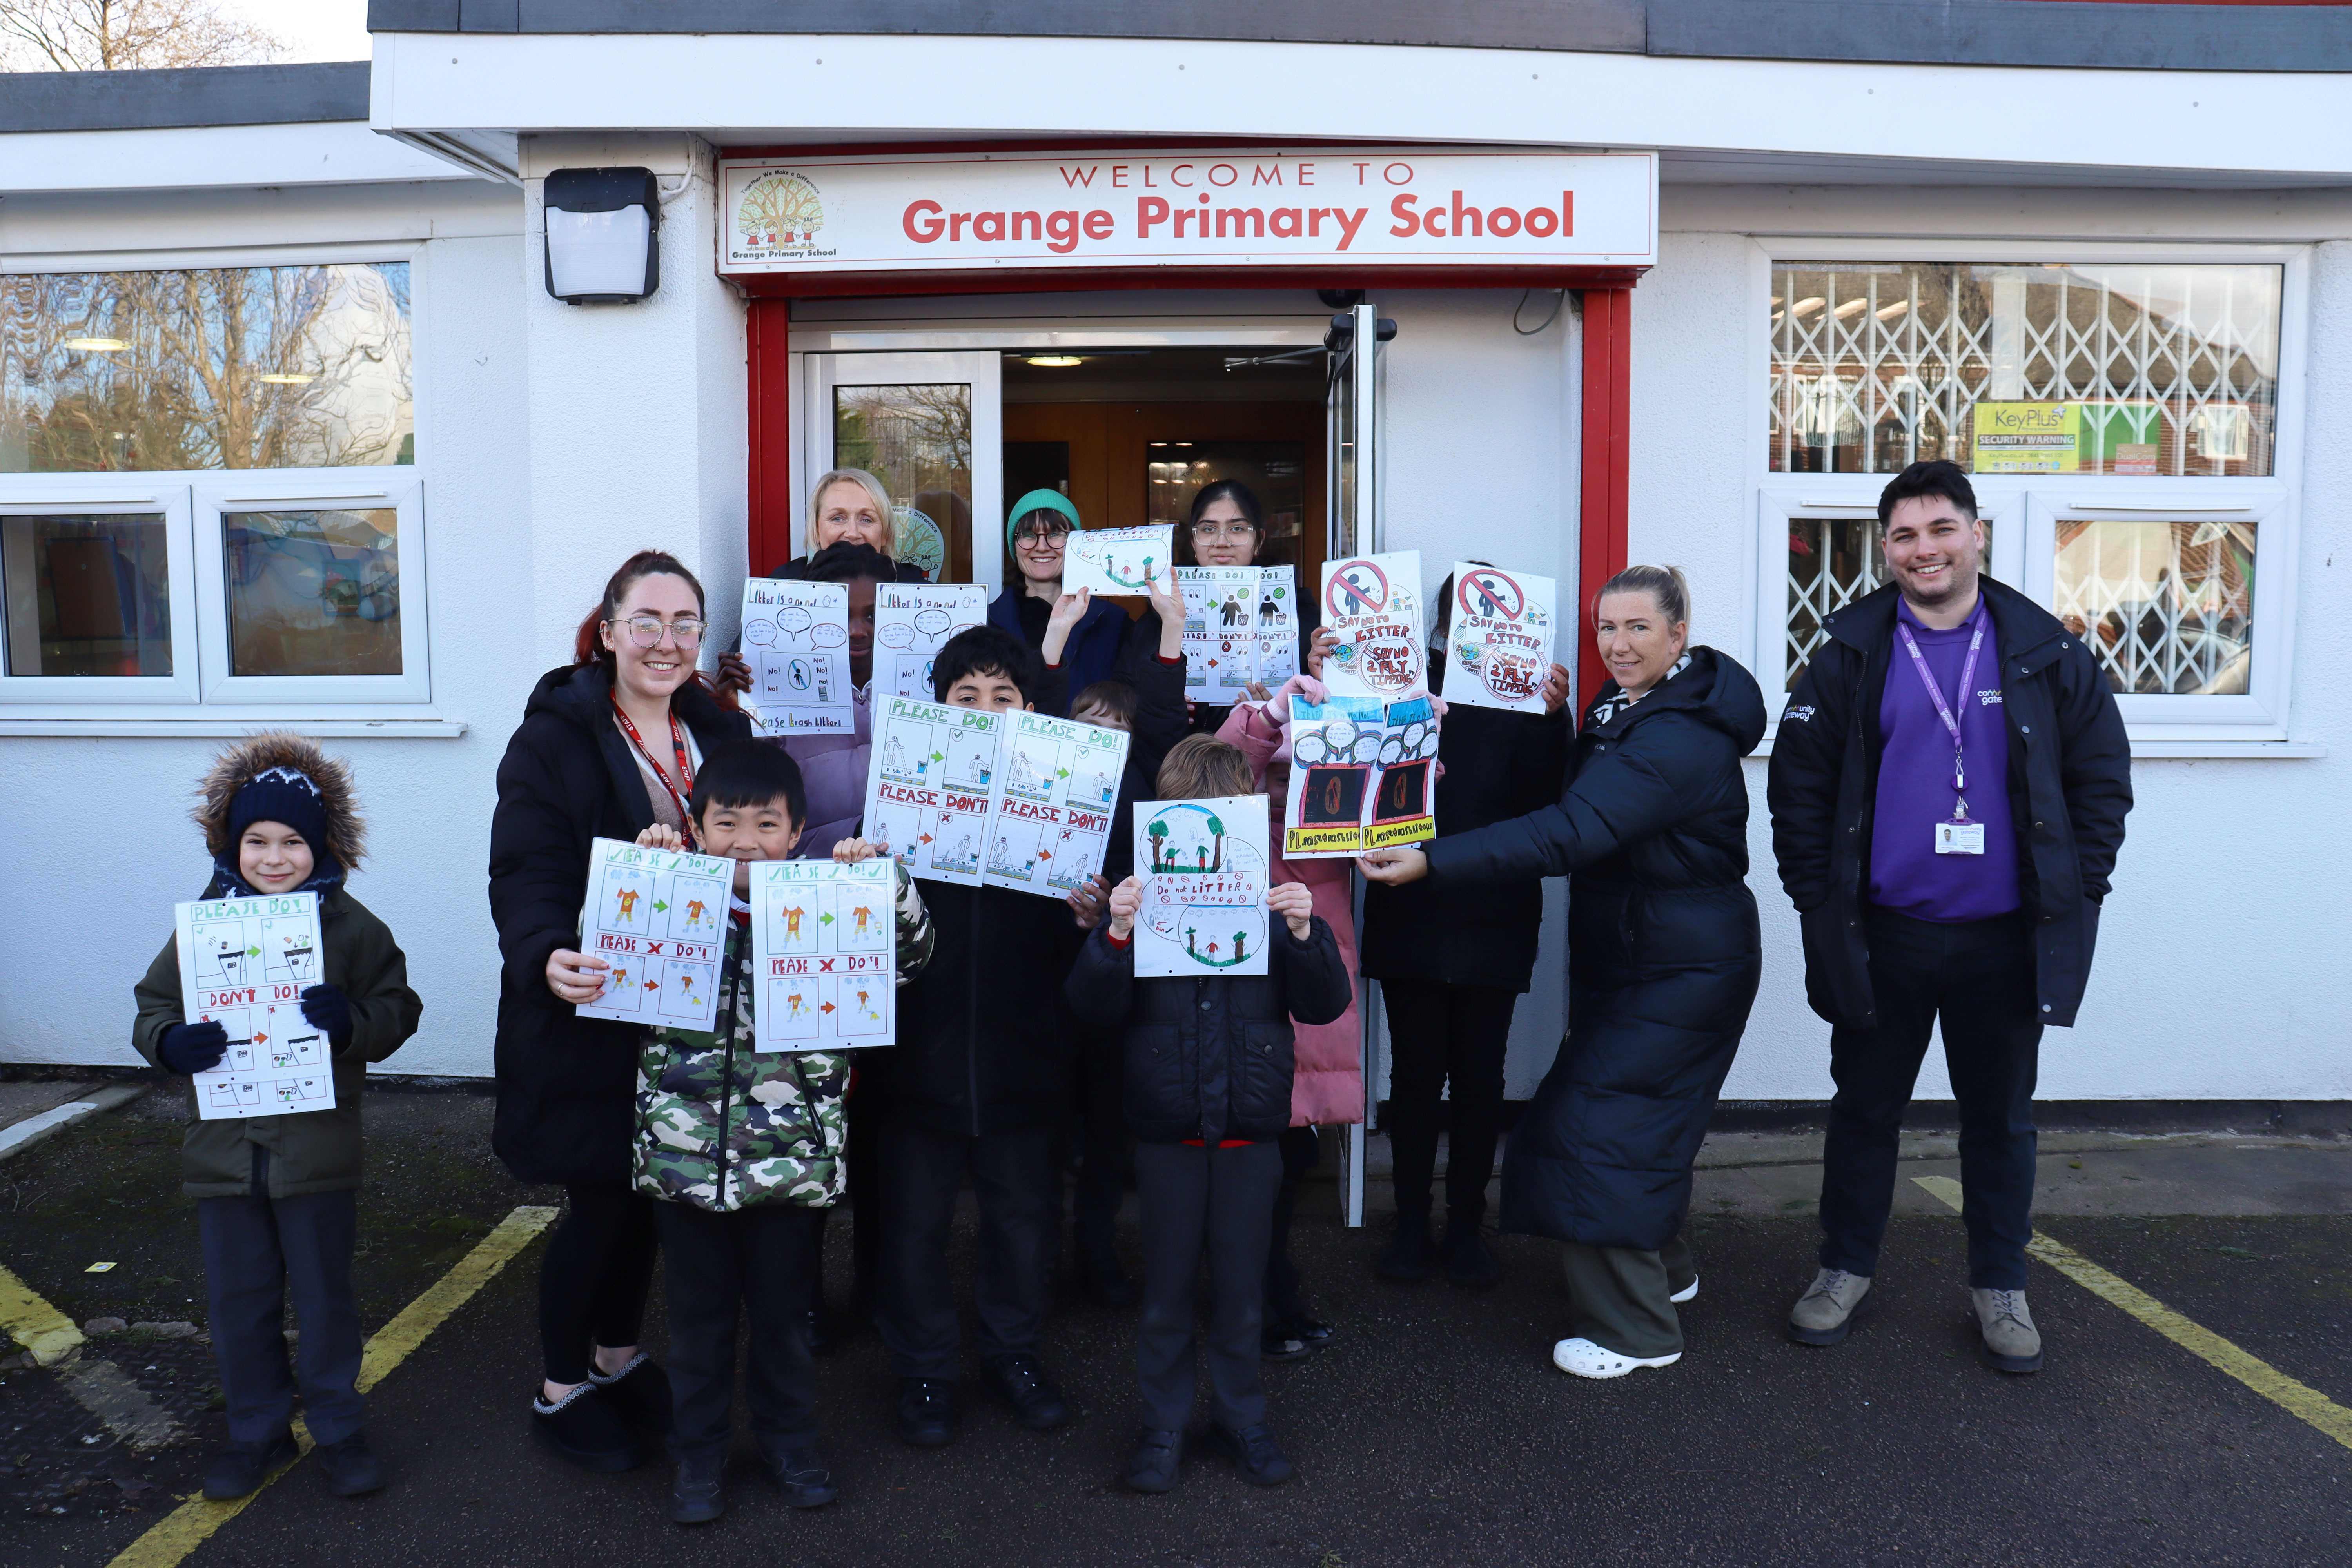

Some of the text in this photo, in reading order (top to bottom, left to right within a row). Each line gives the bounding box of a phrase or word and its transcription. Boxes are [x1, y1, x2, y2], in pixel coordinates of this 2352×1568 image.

[1059, 162, 1414, 188] WELCOME TO
[740, 176, 761, 194] Together
[796, 173, 820, 194] Difference
[902, 190, 1573, 254] Grange Primary School
[769, 250, 804, 259] Primary
[1995, 409, 2058, 431] KeyPlus
[1979, 435, 2074, 444] SECURITY WARNING
[914, 511, 938, 534] Difference
[1177, 570, 1216, 579] PLEASE
[777, 592, 784, 604] is
[914, 596, 922, 608] is
[1338, 615, 1389, 628] SAY NO TO
[1469, 616, 1523, 632] SAY NO TO
[1355, 625, 1410, 642] LITTER
[1486, 633, 1541, 650] LITTER
[1373, 646, 1409, 661] SAY NO
[1500, 652, 1537, 669] SAY NO
[817, 667, 828, 675] No!
[902, 669, 915, 678] No!
[1367, 660, 1408, 674] 2 FLY
[1491, 664, 1501, 677] 2
[1503, 667, 1534, 684] FLY
[1368, 674, 1413, 686] TIPPING
[1491, 679, 1534, 695] TIPPING
[1919, 661, 1928, 677] Community
[1932, 688, 1942, 705] Association
[768, 686, 778, 694] No!
[1982, 695, 2003, 706] gate
[620, 715, 634, 731] STAFF
[789, 712, 813, 727] trash
[892, 700, 994, 730] PLEASE DO!
[1020, 716, 1118, 748] PLEASE DO!
[661, 773, 674, 789] STAFF
[682, 766, 691, 782] STAFF
[879, 783, 988, 814] PLEASE DON'T!
[1003, 799, 1109, 832] PLEASE DON'T!
[688, 858, 706, 871] DO!
[848, 864, 865, 876] DO!
[1158, 886, 1169, 895] Do
[1176, 885, 1187, 893] not
[195, 898, 302, 920] PLEASE DO!
[210, 984, 299, 1006] DON'T DO!
